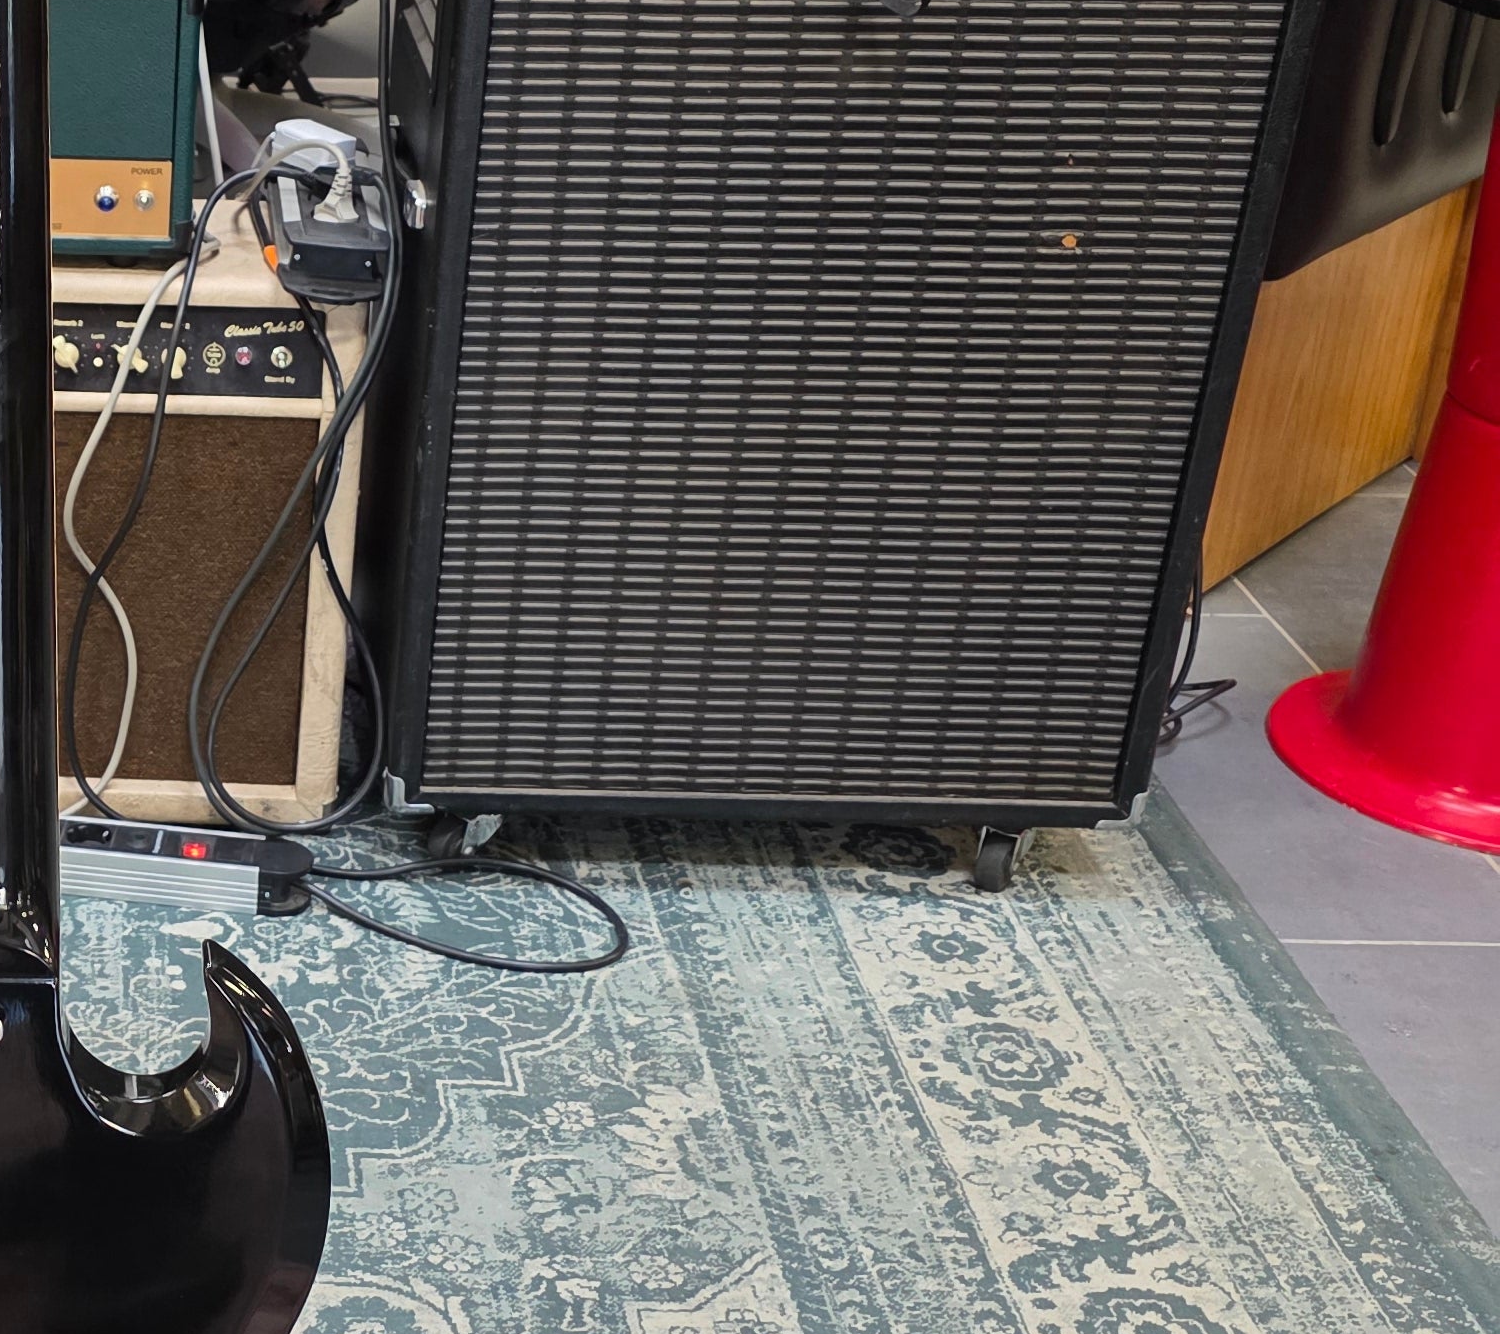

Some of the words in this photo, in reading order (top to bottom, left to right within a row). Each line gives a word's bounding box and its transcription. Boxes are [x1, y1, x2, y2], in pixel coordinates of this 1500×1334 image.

[130, 167, 163, 176] POWER
[223, 324, 262, 338] Classic
[262, 321, 288, 334] Tube
[287, 320, 305, 332] 50
